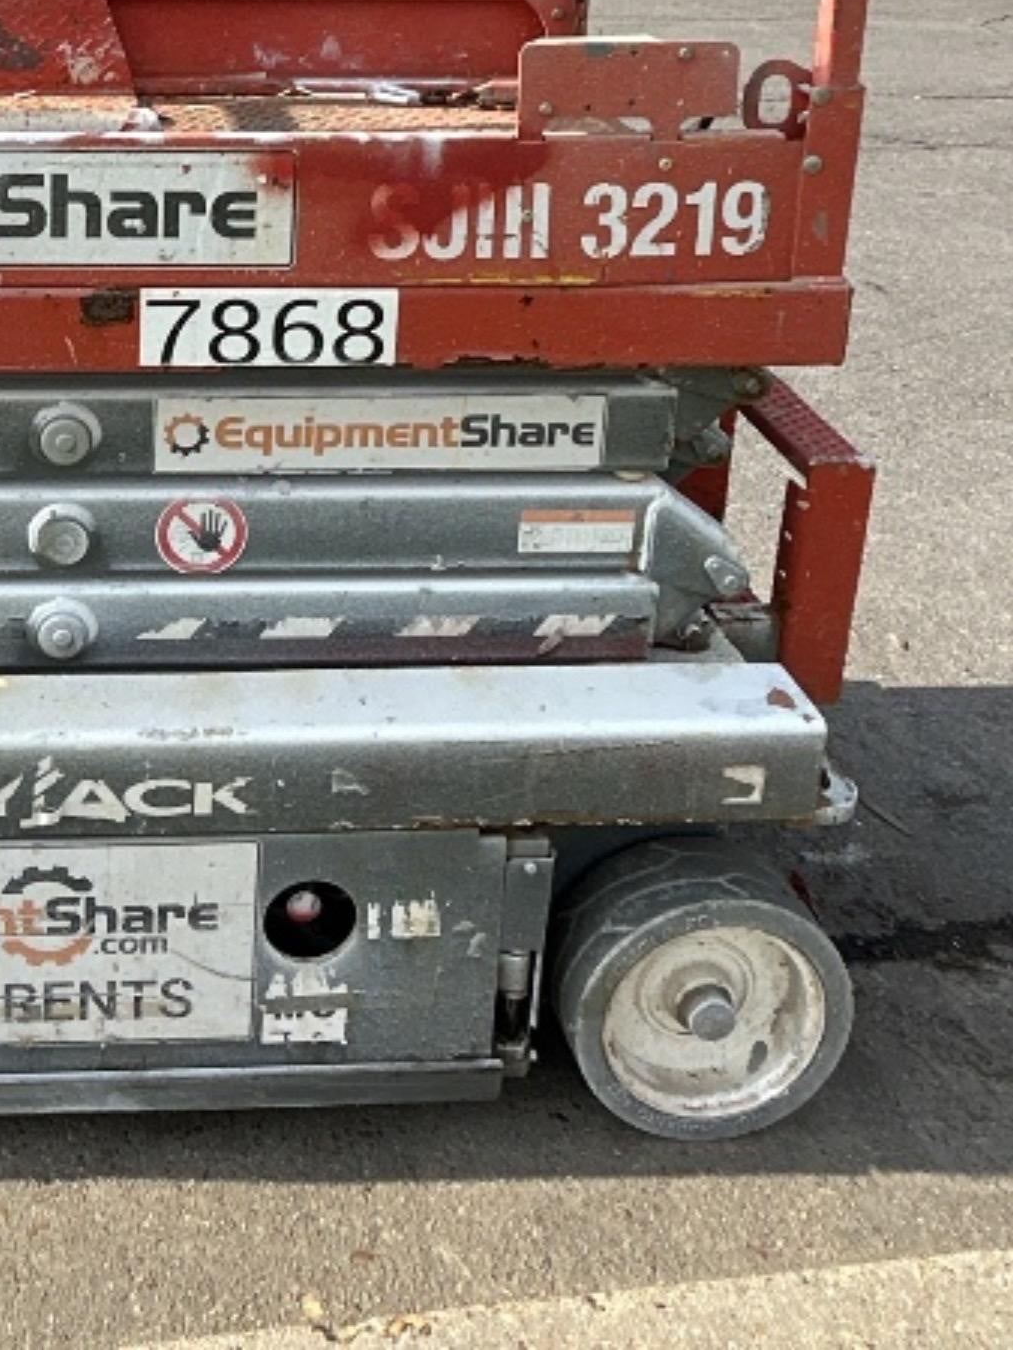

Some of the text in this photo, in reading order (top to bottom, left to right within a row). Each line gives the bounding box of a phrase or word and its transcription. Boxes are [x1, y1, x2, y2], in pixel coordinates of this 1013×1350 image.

[580, 179, 771, 259] 3219
[145, 298, 385, 366] 7868
[215, 413, 596, 457] EquipmentShare
[93, 936, 168, 955] .com
